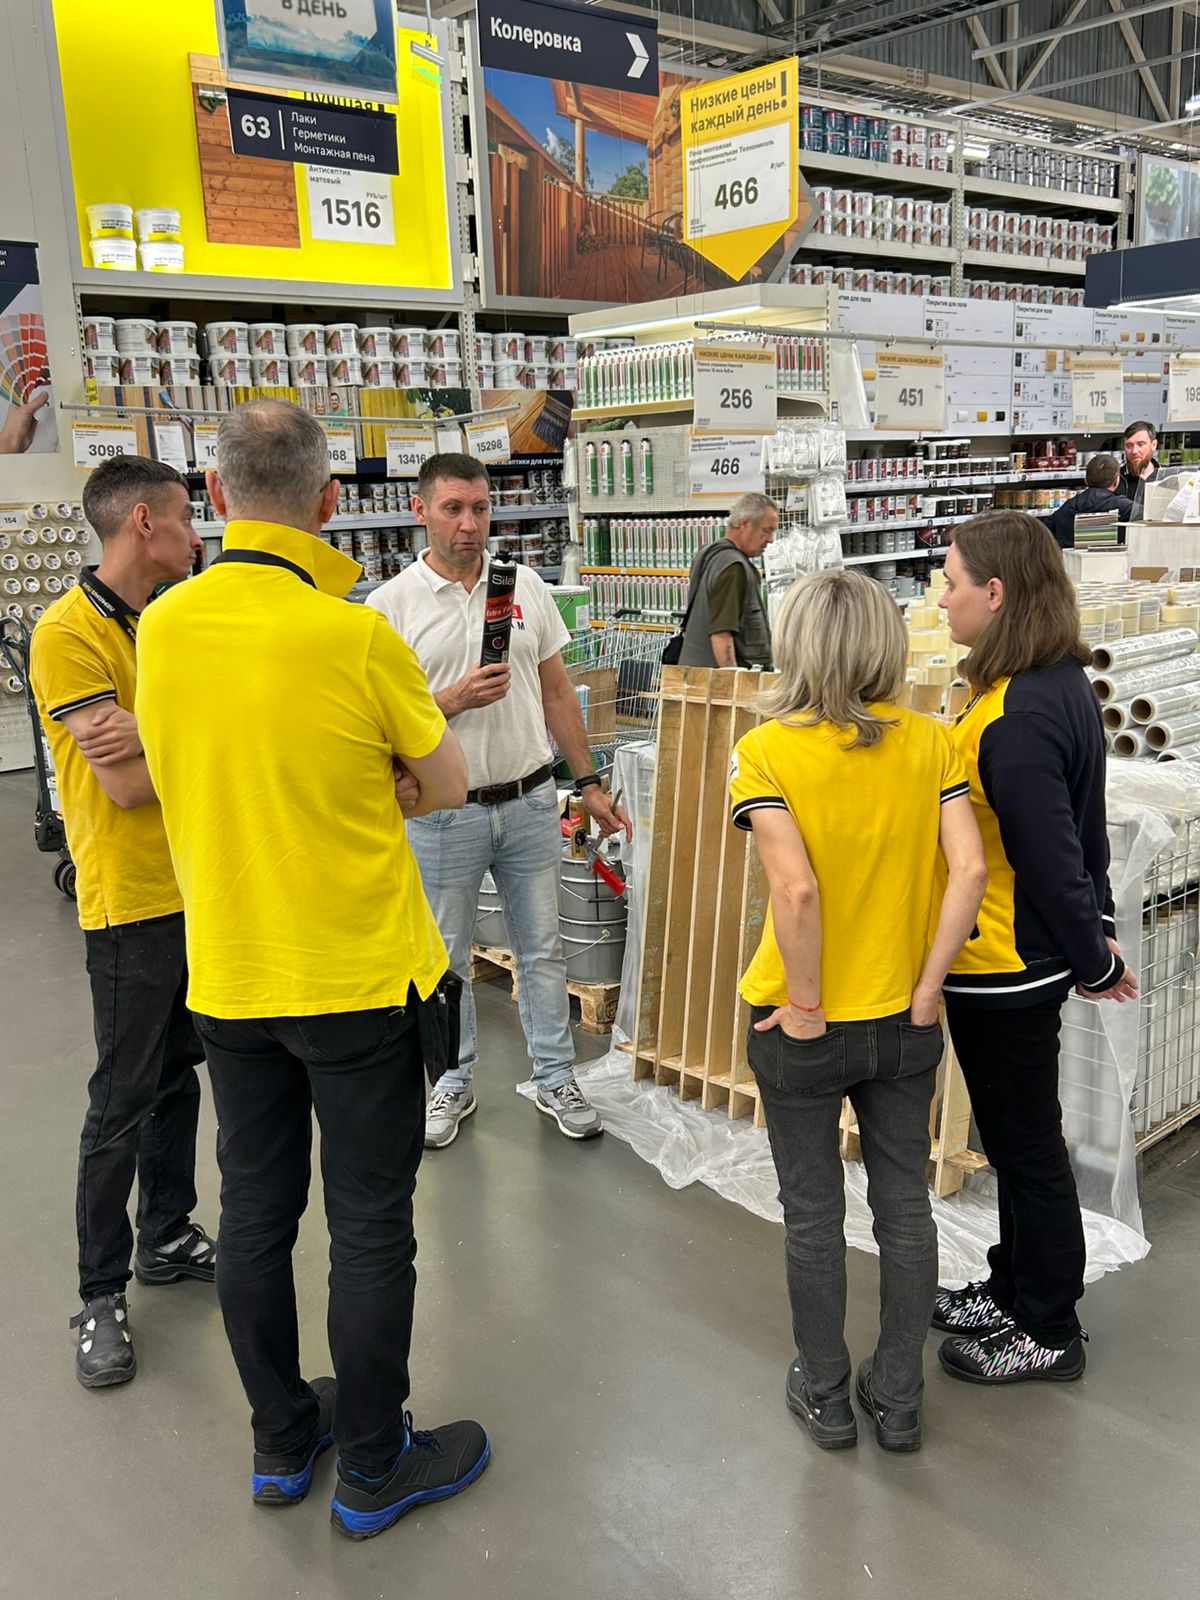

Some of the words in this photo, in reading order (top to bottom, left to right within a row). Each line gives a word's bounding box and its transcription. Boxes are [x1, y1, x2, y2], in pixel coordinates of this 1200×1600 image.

[490, 16, 582, 53] Колеровка
[690, 88, 738, 113] Низкие
[741, 77, 776, 100] цены
[240, 114, 272, 139] 63
[290, 111, 317, 125] Лаки
[691, 104, 744, 134] каждый
[292, 127, 347, 144] Герметики
[293, 142, 351, 160] Монтажная
[352, 149, 376, 163] пена
[308, 165, 352, 176] Антисептик
[309, 176, 342, 185] матовый
[714, 176, 759, 210] 466
[321, 198, 382, 229] 1516
[720, 387, 753, 410] 256
[898, 387, 924, 407] 451
[1089, 390, 1108, 407] 175
[89, 444, 124, 457] 3098
[476, 438, 503, 453] 15298
[398, 453, 427, 465] 13416
[711, 457, 740, 476] 466
[492, 574, 515, 585] Sila
